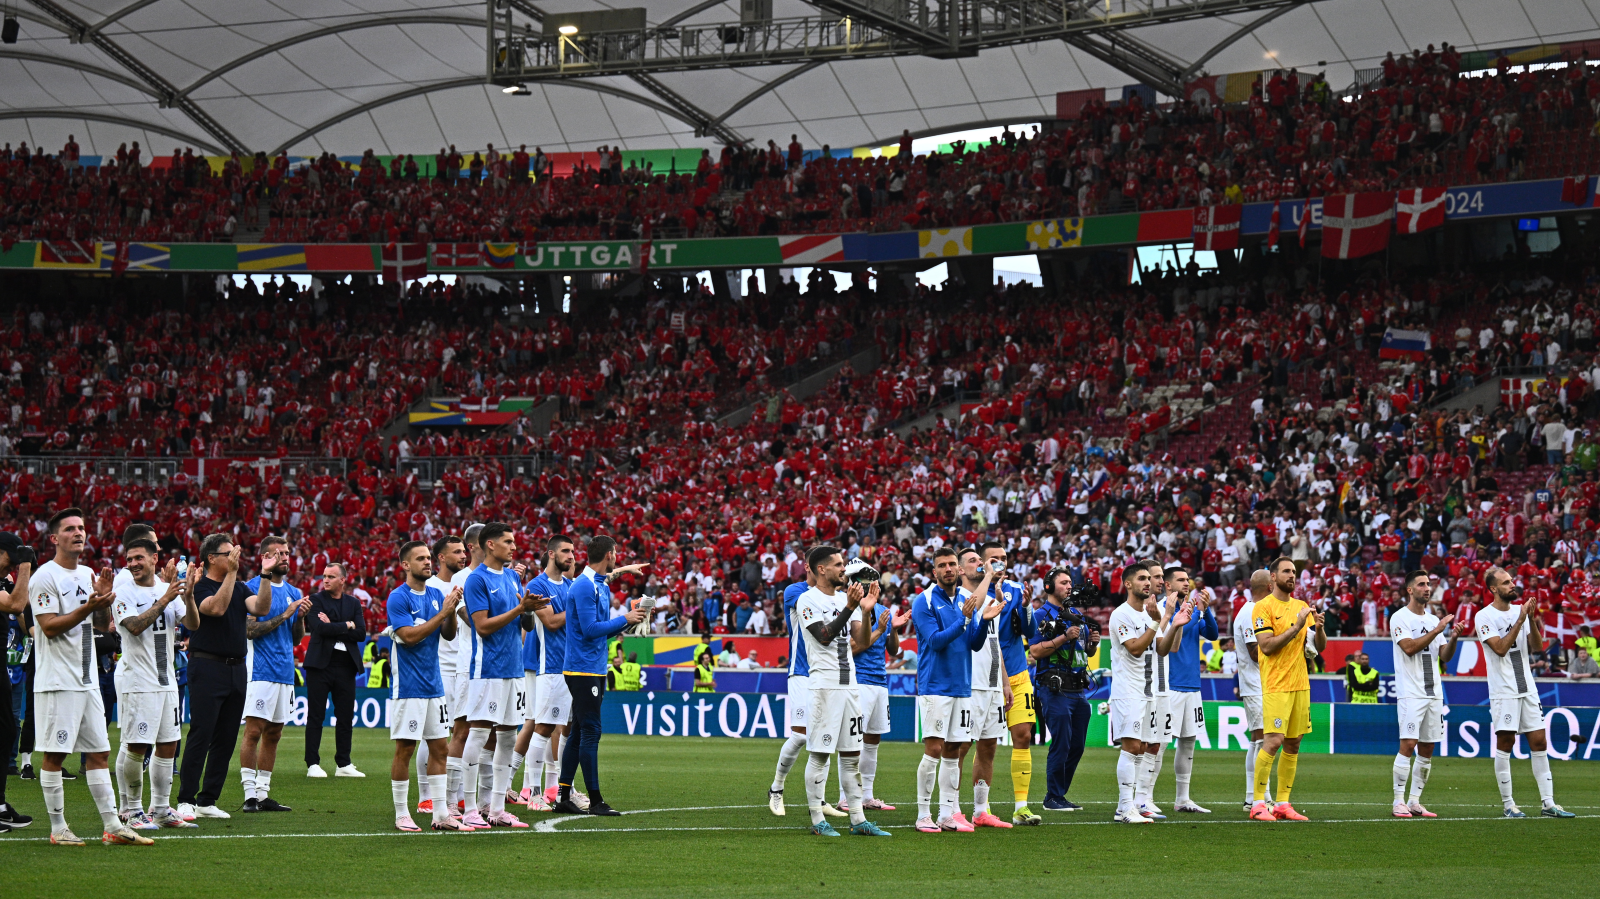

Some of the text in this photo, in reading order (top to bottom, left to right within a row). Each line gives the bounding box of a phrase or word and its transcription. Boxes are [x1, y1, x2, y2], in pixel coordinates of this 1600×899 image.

[1445, 190, 1484, 214] 024
[516, 691, 526, 710] 24
[622, 691, 791, 738] visitQAT
[1194, 706, 1203, 723] 18
[850, 716, 862, 736] 20
